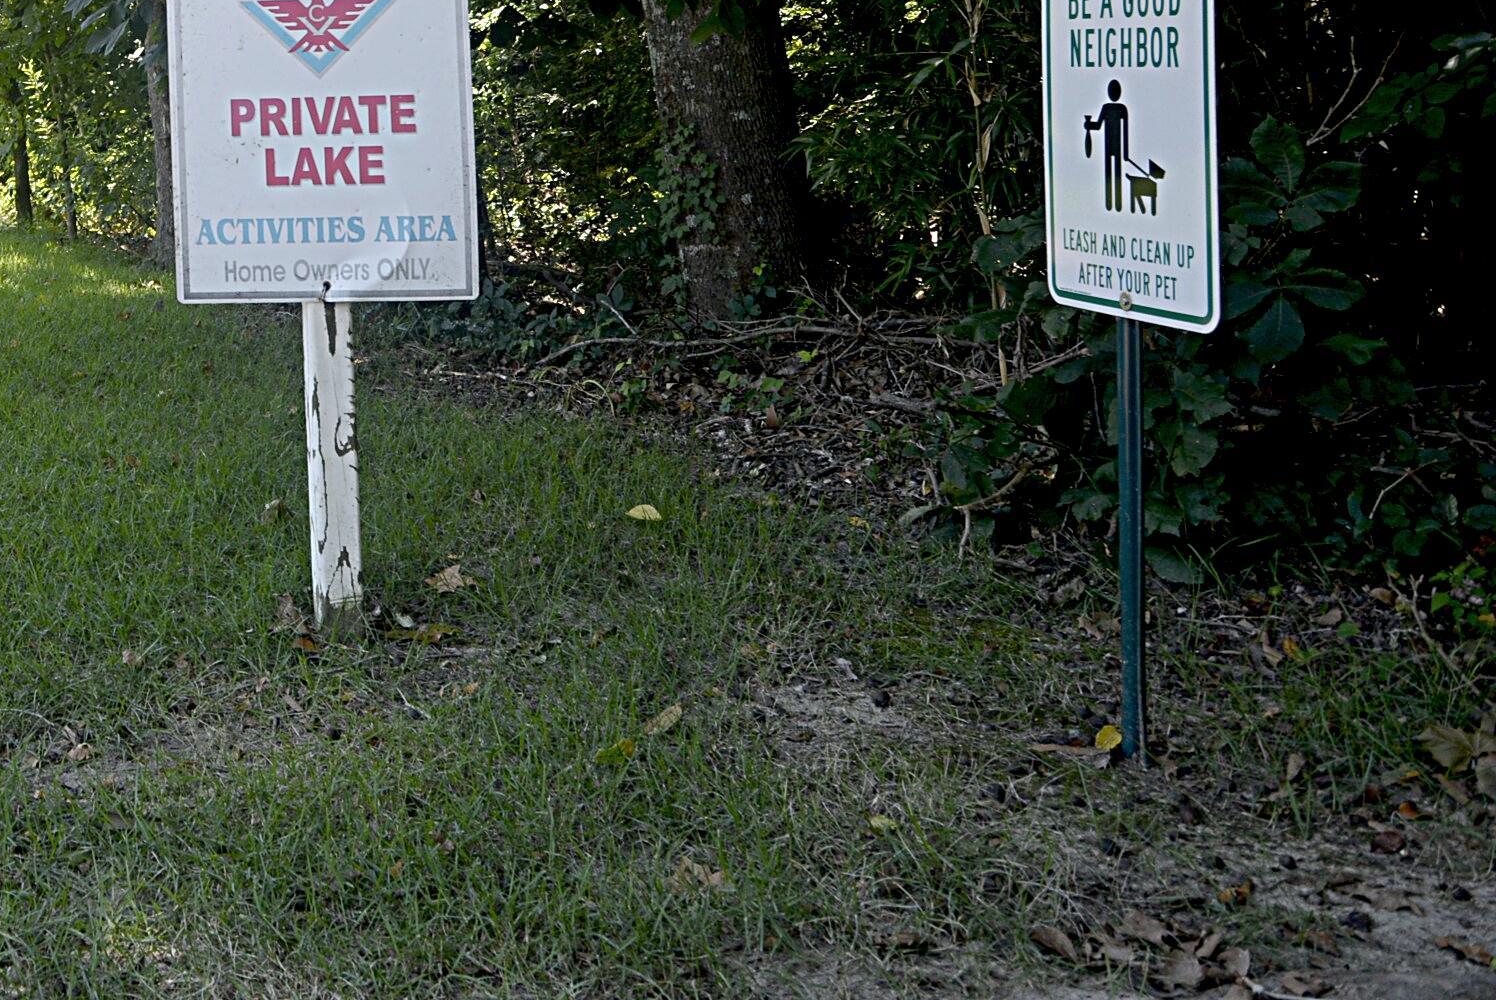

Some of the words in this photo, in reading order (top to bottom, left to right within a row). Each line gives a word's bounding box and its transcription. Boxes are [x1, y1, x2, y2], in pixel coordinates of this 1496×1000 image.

[1070, 26, 1180, 68] NEIGHBOR
[230, 95, 417, 137] PRIVATE
[265, 145, 386, 187] LAKE
[196, 216, 365, 246] ACTIVITIES
[374, 215, 457, 242] AREA
[1063, 227, 1097, 255] LEASH
[1102, 234, 1126, 259] AND
[1131, 238, 1171, 266] CLEAN
[1177, 244, 1195, 269] UP
[225, 260, 286, 283] Home
[294, 258, 370, 282] Owners
[1078, 262, 1113, 289] AFTER
[1117, 269, 1150, 296] YOUR
[1155, 275, 1177, 301] PET
